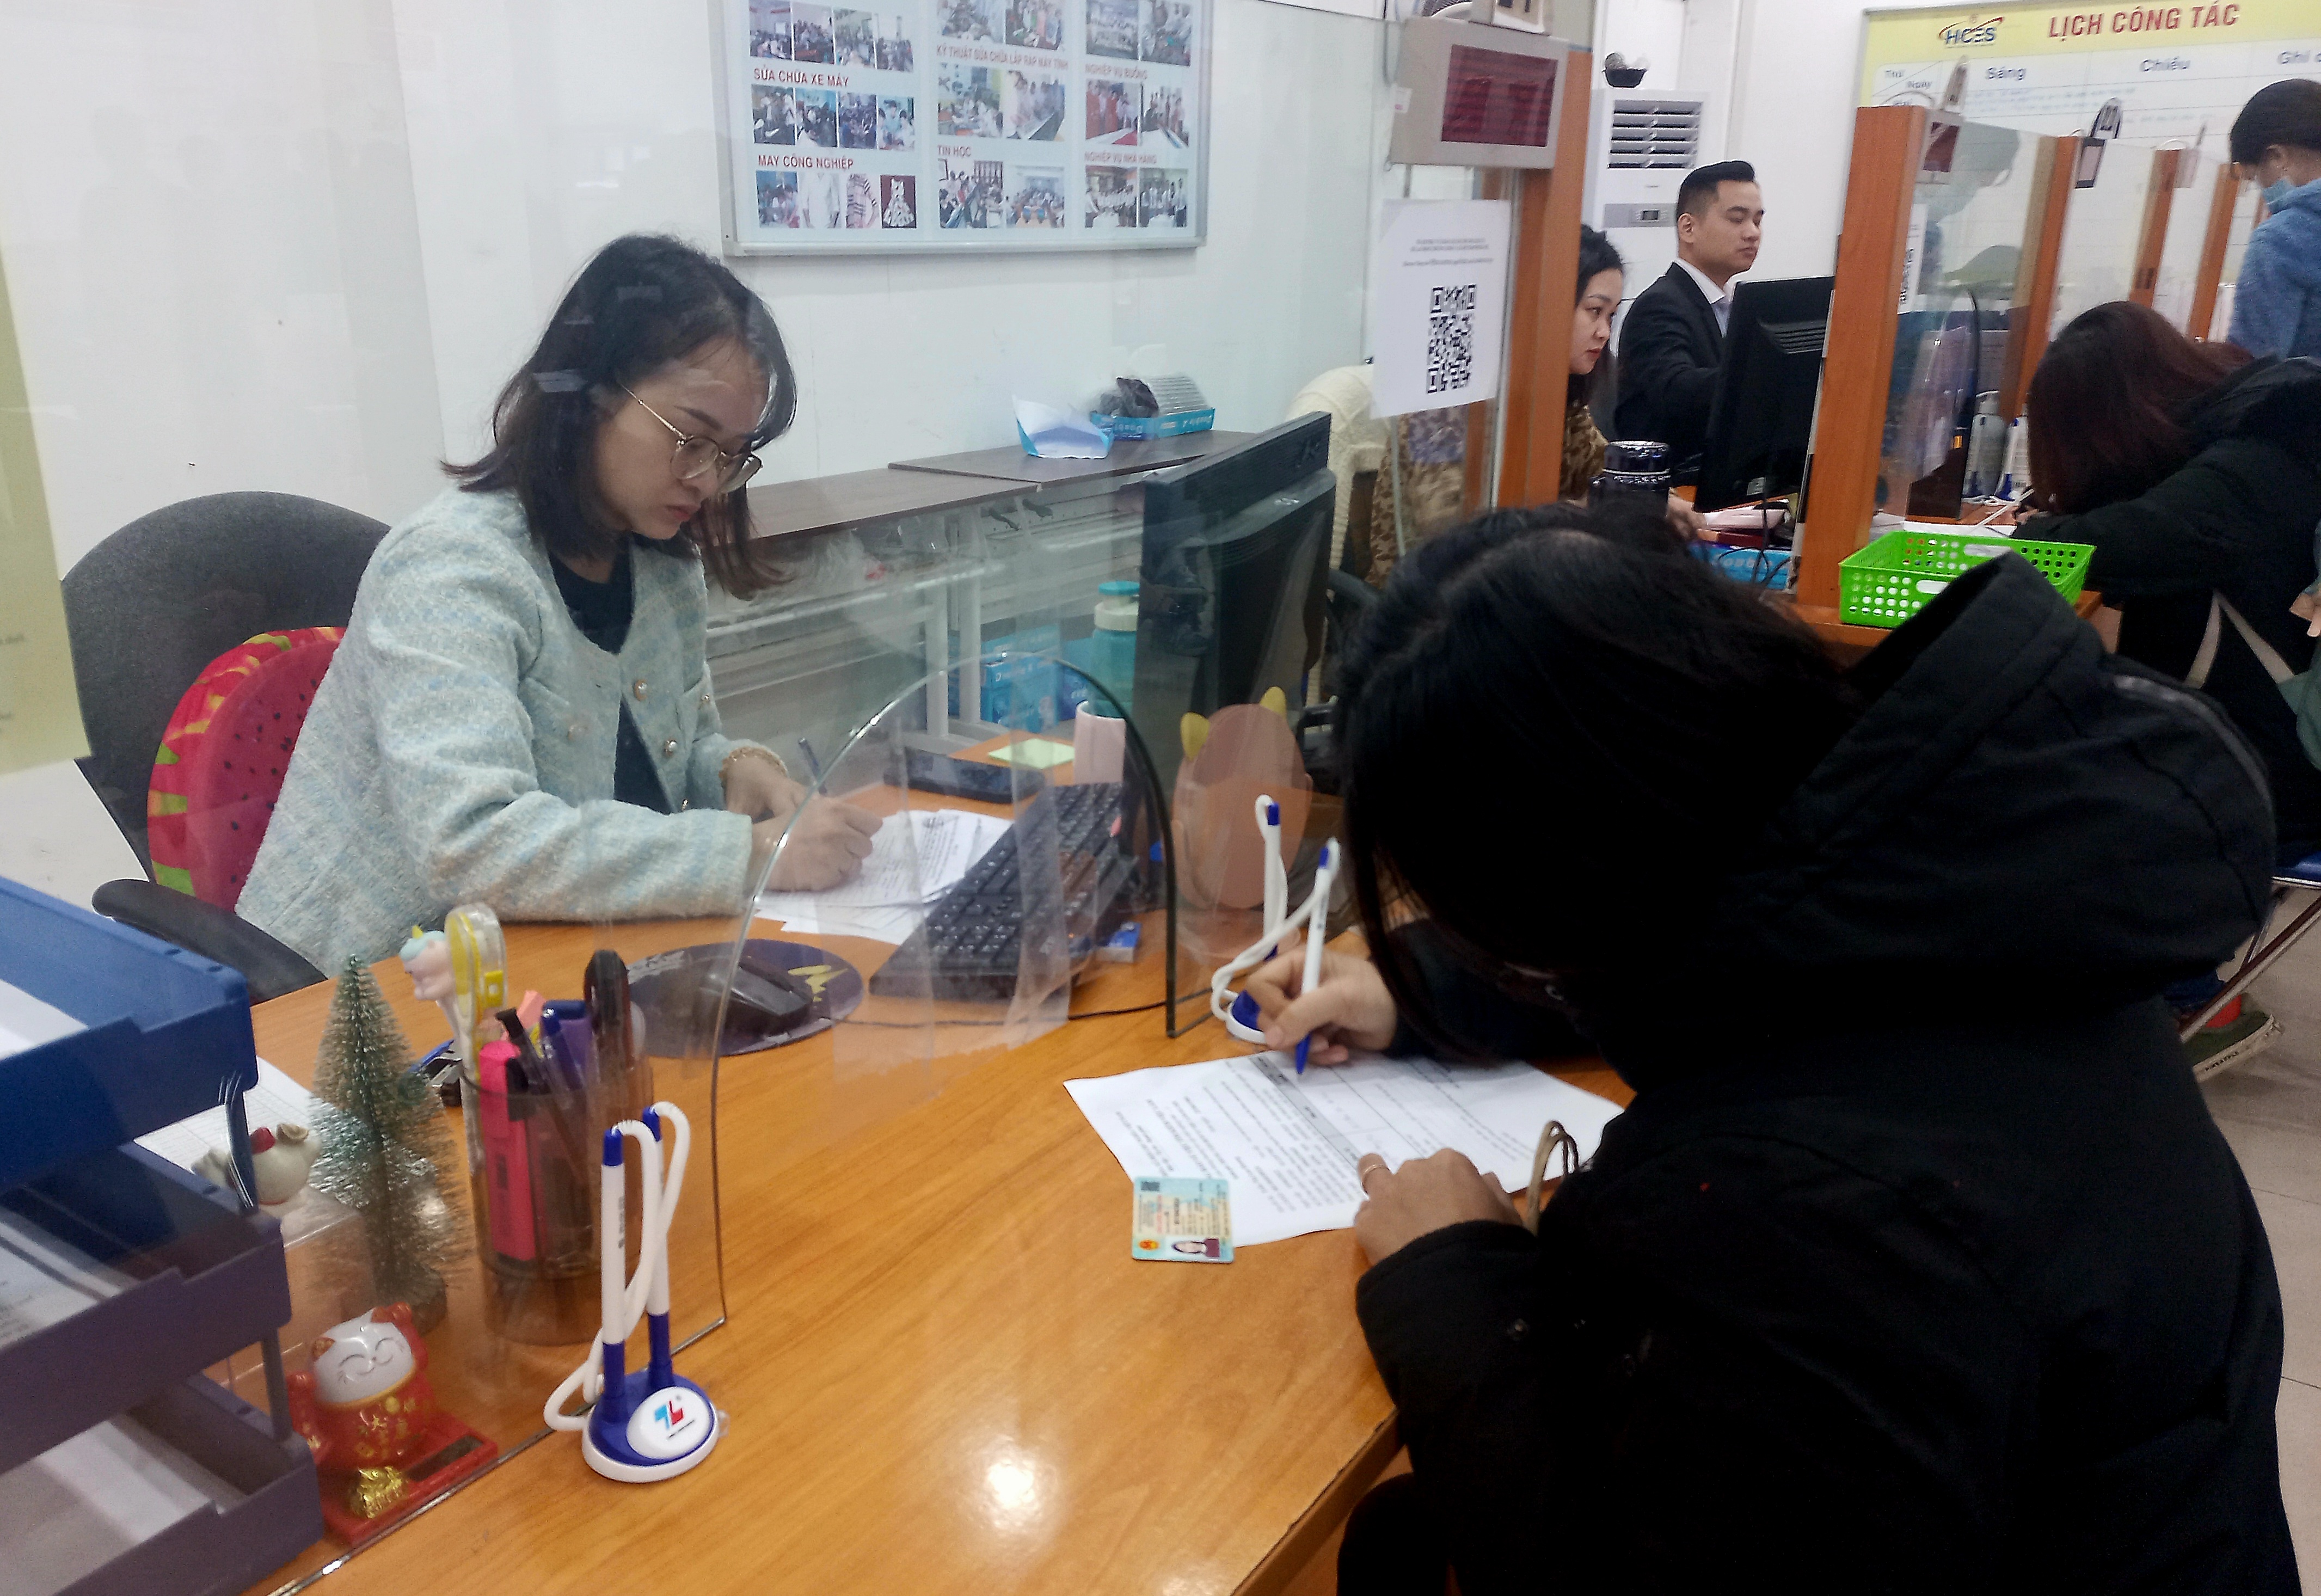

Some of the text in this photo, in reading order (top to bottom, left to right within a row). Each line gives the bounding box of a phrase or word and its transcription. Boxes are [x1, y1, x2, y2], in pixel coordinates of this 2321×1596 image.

[2049, 0, 2239, 42] LỊCH CÔNG TÁC
[1946, 26, 1996, 44] HCES
[812, 73, 824, 85] XE
[827, 73, 849, 87] MÁY
[1986, 66, 2026, 81] Sáng
[938, 145, 971, 158] TIN HỌC
[758, 153, 854, 172] MAY CÔNG NGHIỆP
